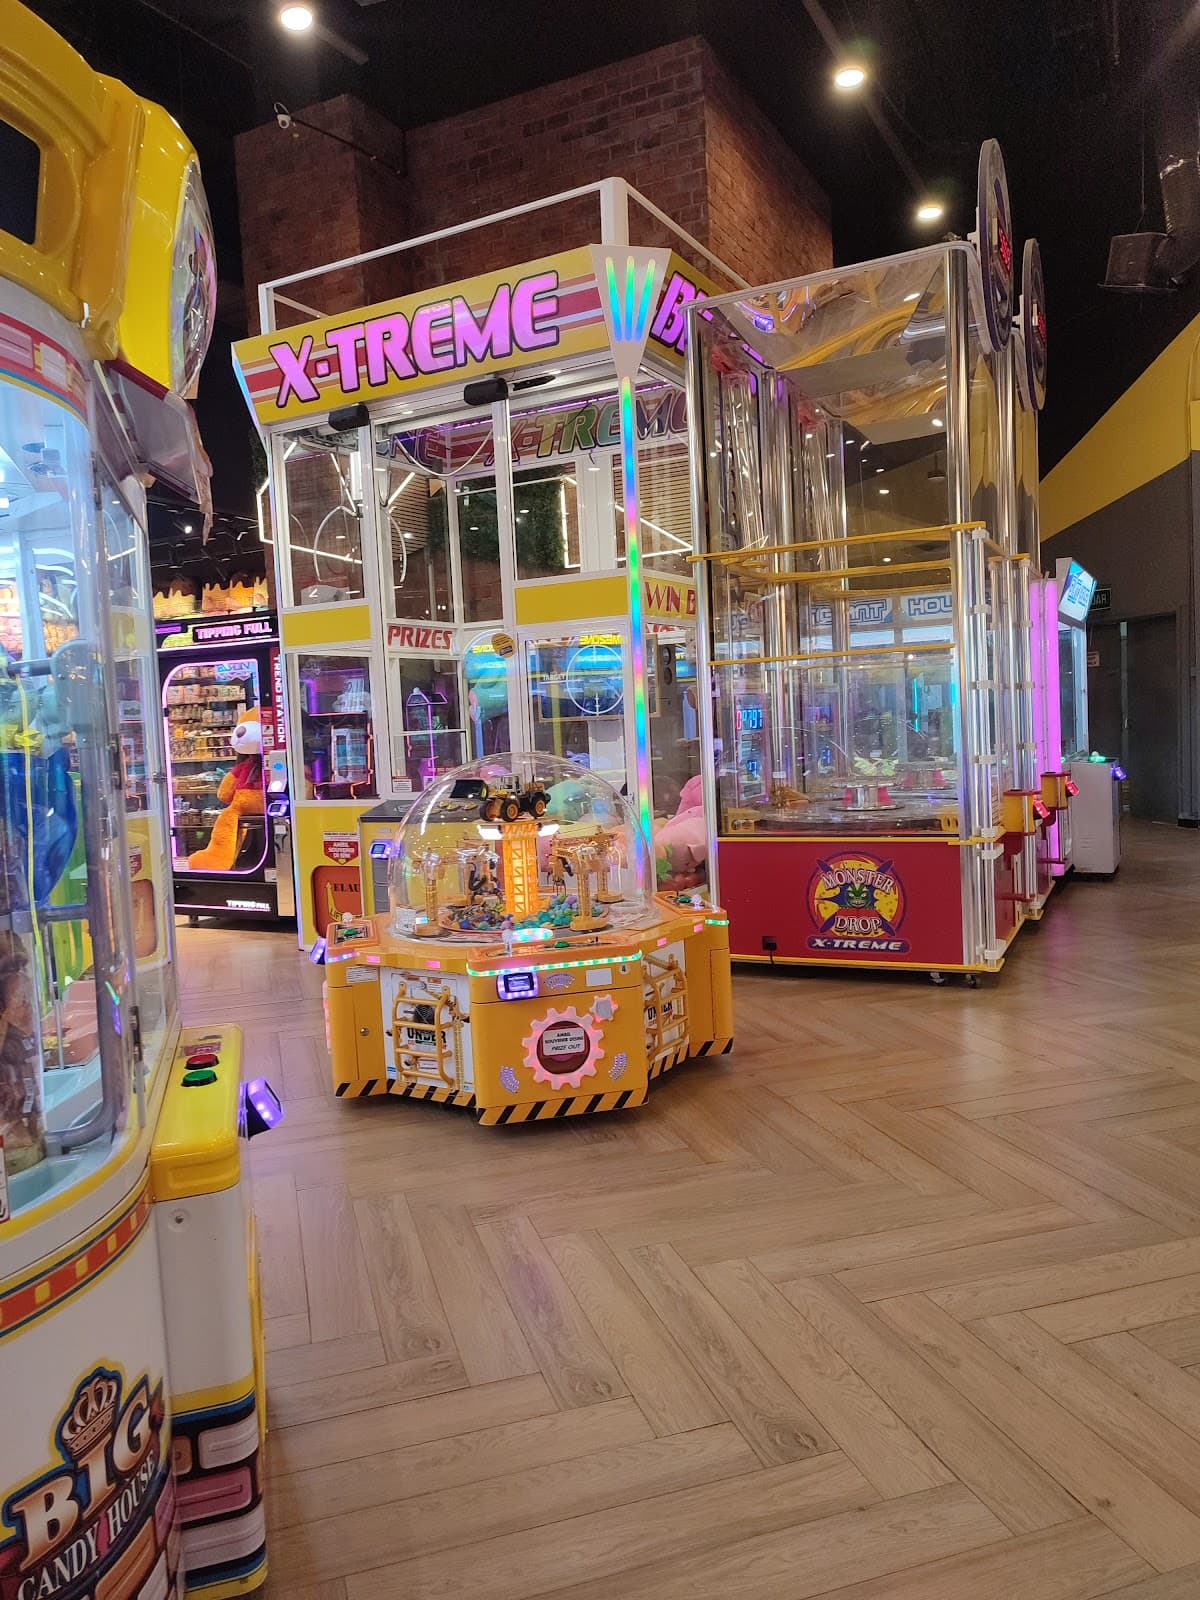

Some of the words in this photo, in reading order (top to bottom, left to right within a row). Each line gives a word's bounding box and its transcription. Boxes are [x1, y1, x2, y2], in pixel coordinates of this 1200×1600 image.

[268, 270, 560, 408] X-TREME
[644, 581, 681, 613] WIN
[196, 624, 242, 640] TIPPING
[243, 621, 272, 635] FULL
[387, 624, 453, 651] PRIZES
[272, 654, 282, 694] TREND
[274, 697, 286, 743] STATION
[333, 883, 361, 892] ELAU
[821, 867, 895, 894] MONSTER
[834, 915, 882, 933] DROP
[813, 938, 903, 951] X-TREME
[13, 1381, 154, 1570] BIG
[17, 1521, 99, 1600] CANDY
[105, 1449, 156, 1544] HOUSE
